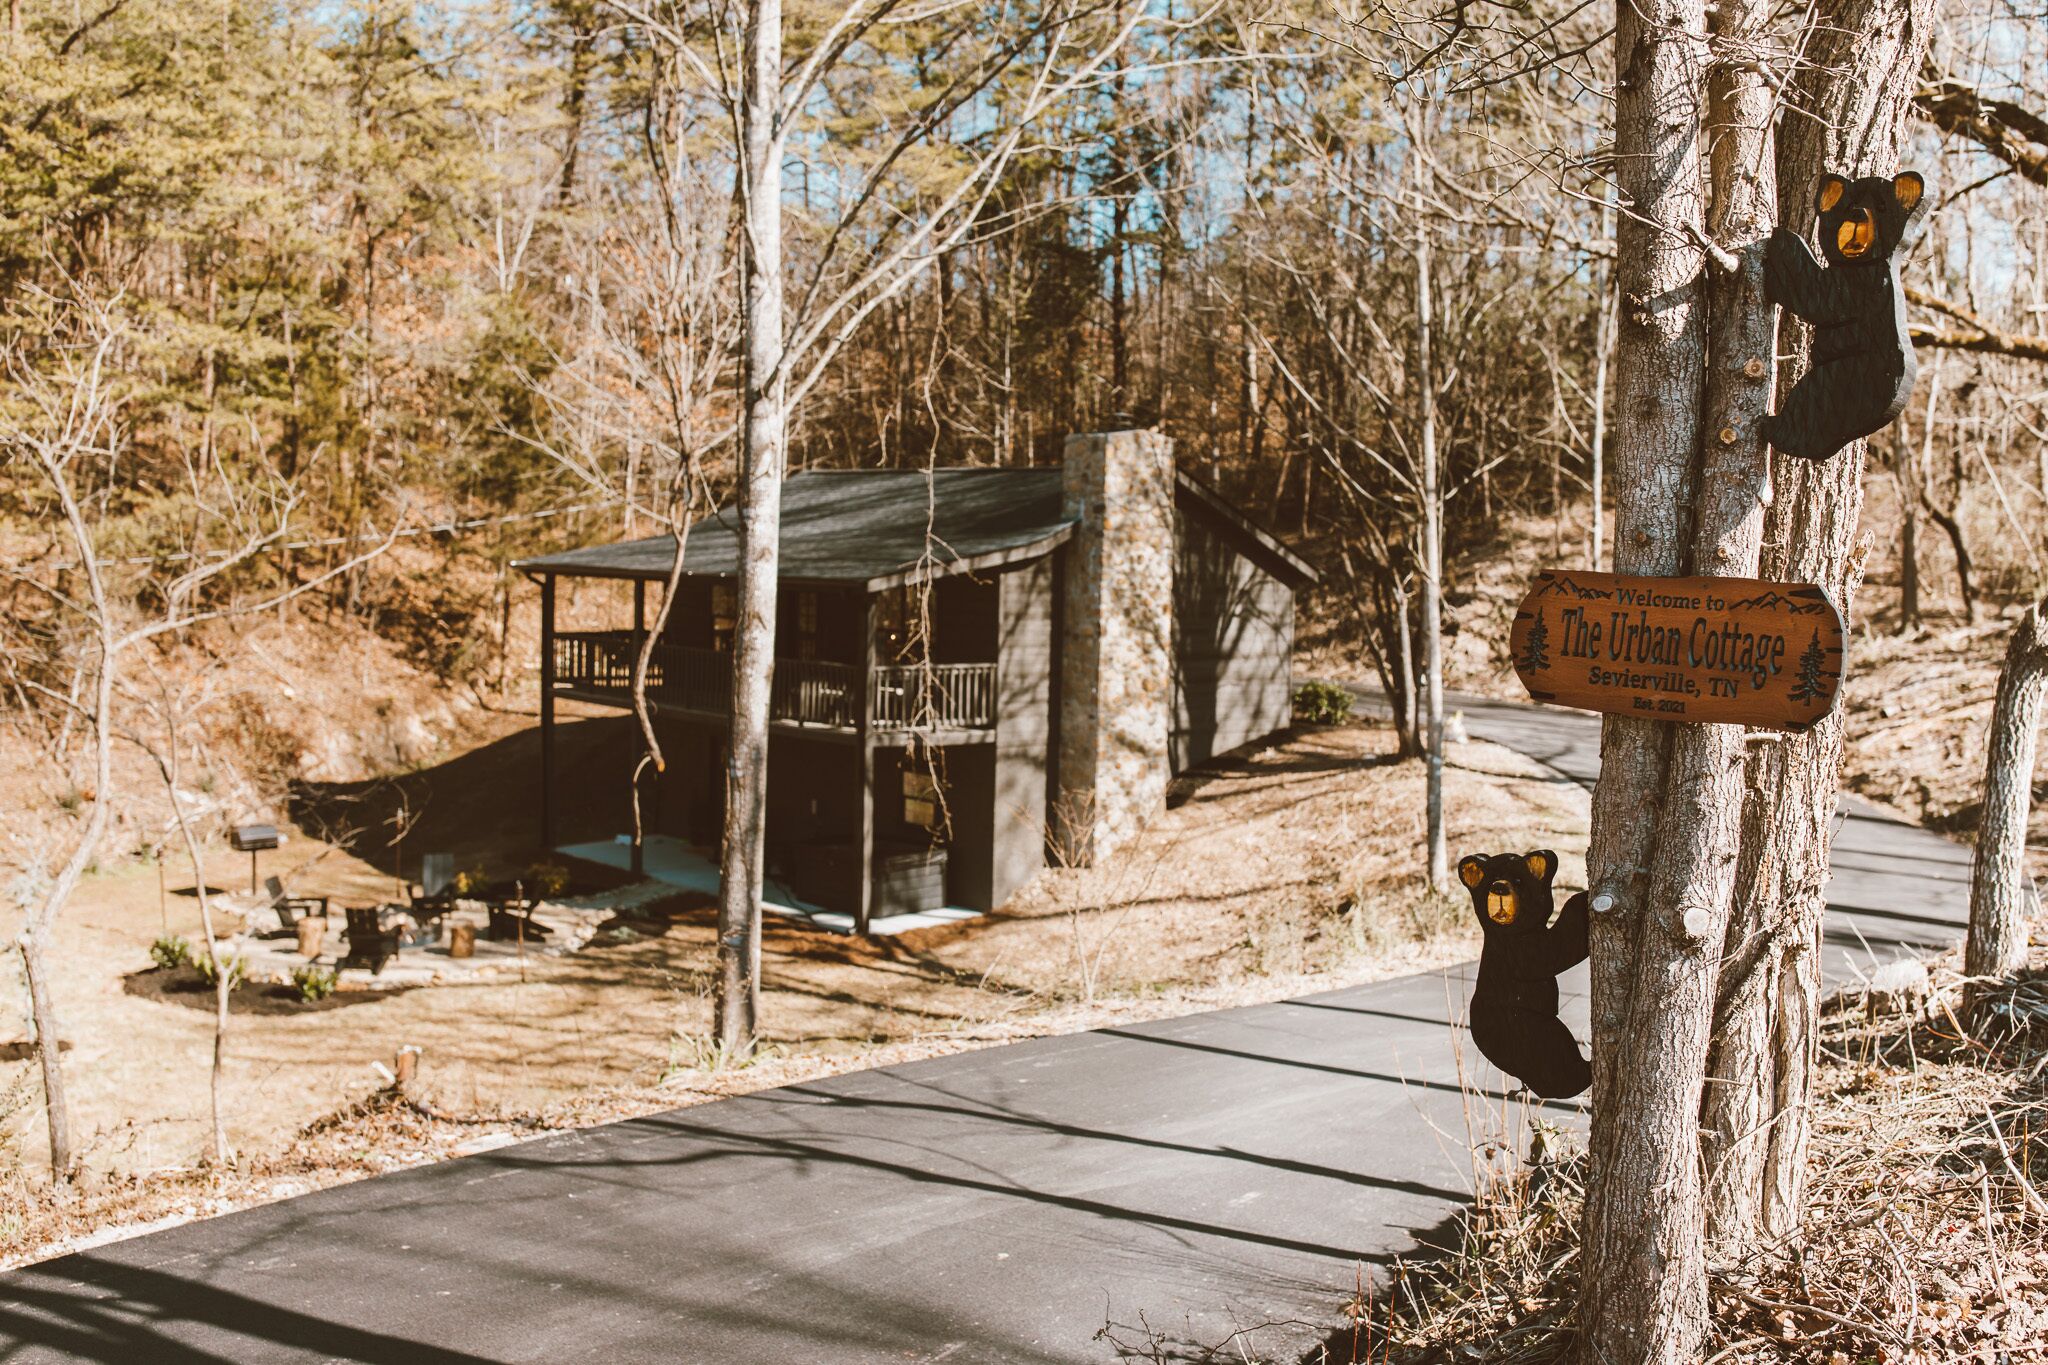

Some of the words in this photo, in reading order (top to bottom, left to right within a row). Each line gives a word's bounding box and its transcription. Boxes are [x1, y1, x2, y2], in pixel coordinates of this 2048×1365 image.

[1616, 588, 1699, 609] Welcome
[1706, 593, 1725, 611] to
[1560, 606, 1600, 658] The
[1608, 611, 1680, 665] Urban
[1687, 617, 1785, 690] Cottage
[1588, 666, 1700, 698] Sevierville,
[1708, 677, 1740, 698] TN
[1633, 697, 1655, 711] Est.
[1659, 700, 1686, 714] 2021
